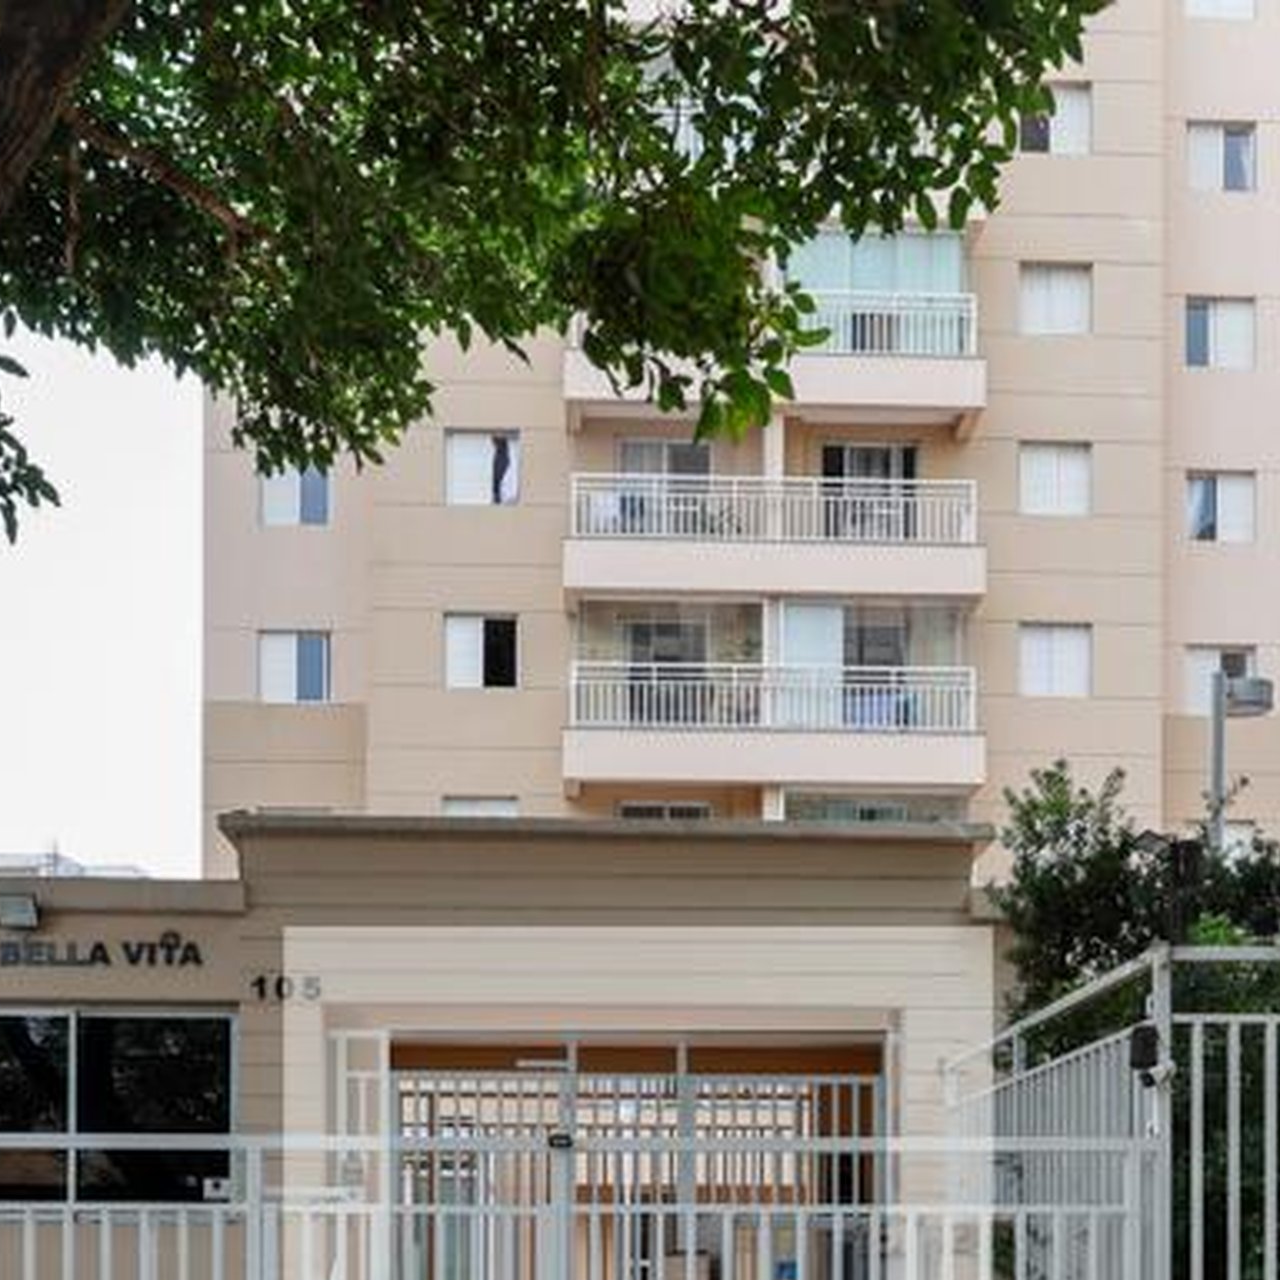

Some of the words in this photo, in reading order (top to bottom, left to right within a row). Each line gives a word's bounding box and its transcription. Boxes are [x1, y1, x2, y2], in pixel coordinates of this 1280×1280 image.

[0, 941, 111, 966] BELLA
[121, 940, 203, 966] VITA
[250, 974, 322, 1000] 105
